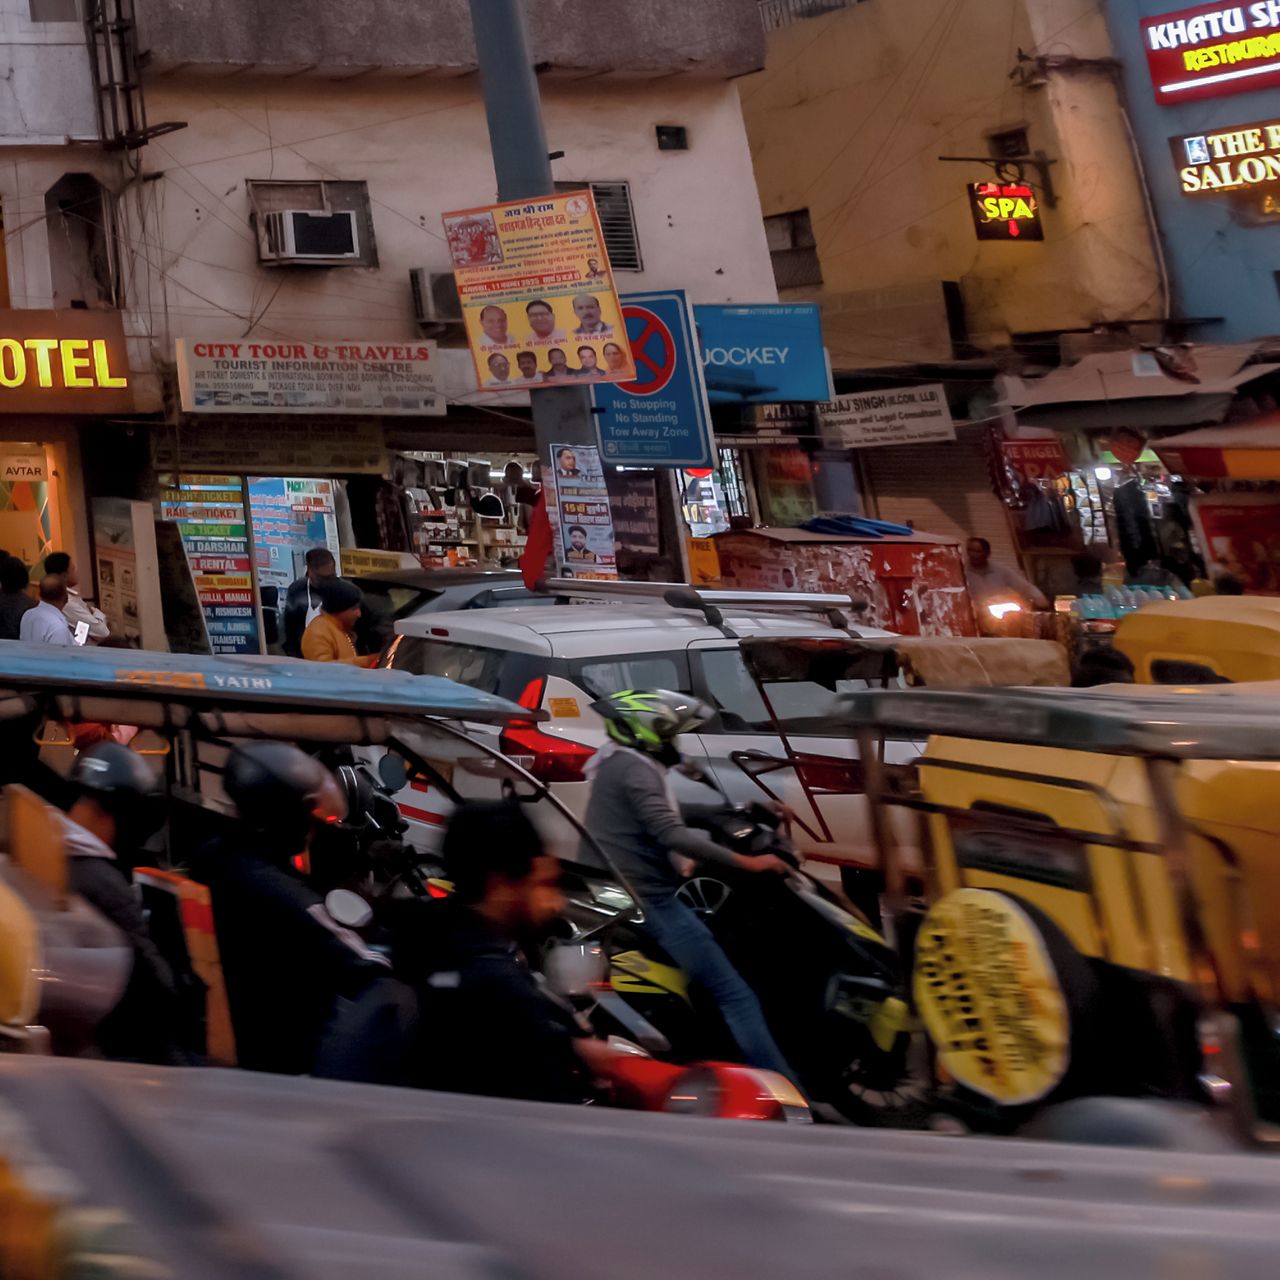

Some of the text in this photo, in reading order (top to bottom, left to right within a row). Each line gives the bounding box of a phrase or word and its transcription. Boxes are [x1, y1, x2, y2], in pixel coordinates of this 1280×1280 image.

[1148, 7, 1246, 50] KHATU
[1207, 128, 1265, 158] THE
[1180, 154, 1280, 192] SALON
[984, 197, 1034, 218] SPA
[193, 343, 429, 361] CITY TOUR & TRAVELS
[702, 347, 789, 366] JOCKEY
[214, 360, 413, 373] TOURIST INFORMATION CENTRE
[612, 400, 676, 412] No Stopping
[819, 399, 851, 416] BAJAJ
[854, 396, 886, 412] SINGH
[615, 413, 678, 425] No Standing
[609, 427, 689, 439] Tow Away Zone
[1024, 447, 1061, 458] RIGEL
[6, 467, 42, 476] AVTAR
[202, 492, 233, 502] TICKET
[198, 525, 231, 535] TICKET
[197, 542, 244, 553] DARSHAN
[200, 558, 237, 570] RENTAL
[213, 675, 272, 689] YATRI
